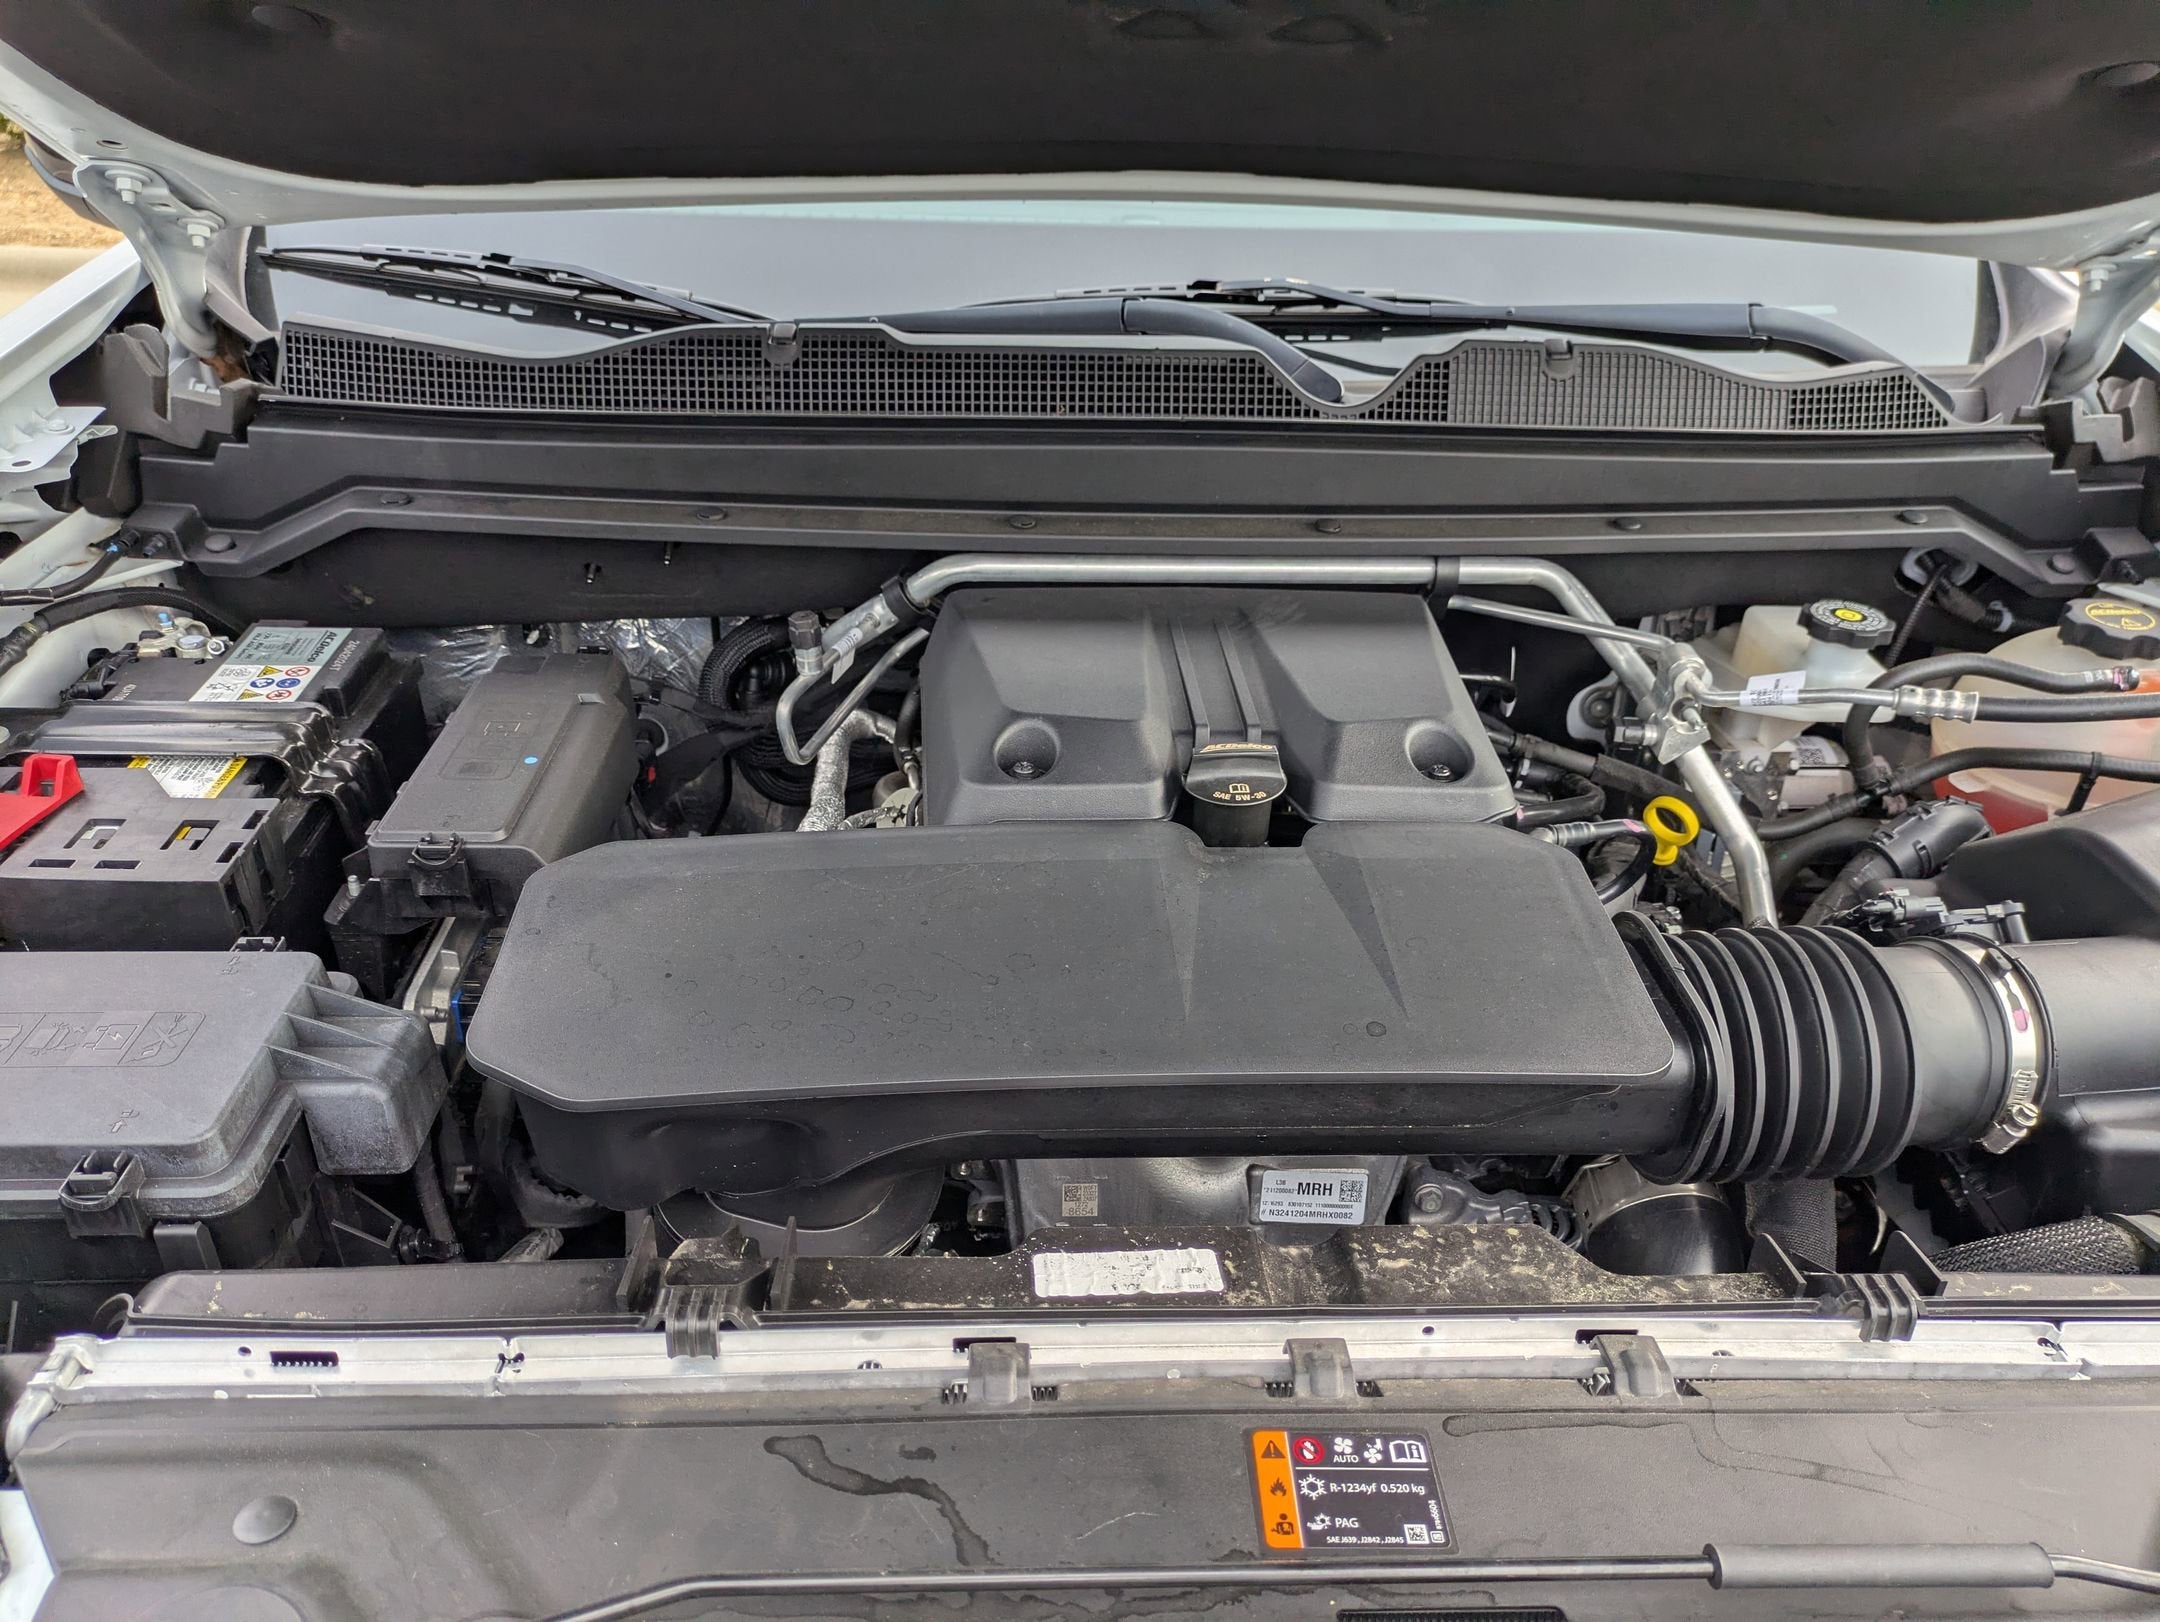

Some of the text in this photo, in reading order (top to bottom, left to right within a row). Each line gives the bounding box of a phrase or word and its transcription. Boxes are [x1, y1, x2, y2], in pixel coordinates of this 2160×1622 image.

[307, 630, 338, 663] ACDelco
[1200, 743, 1273, 753] ACDelco
[1212, 791, 1267, 801] SAE 5W-30
[1297, 1182, 1333, 1196] MRH
[1068, 1207, 1095, 1216] 8654
[1268, 1209, 1354, 1220] N3241204MRHX0082
[1333, 1455, 1359, 1463] AUTO
[1329, 1482, 1426, 1496] R-1234yf 0.520 kg
[1334, 1517, 1360, 1529] PAG
[1326, 1535, 1340, 1544] SAE
[1384, 1536, 1405, 1544] J2845
